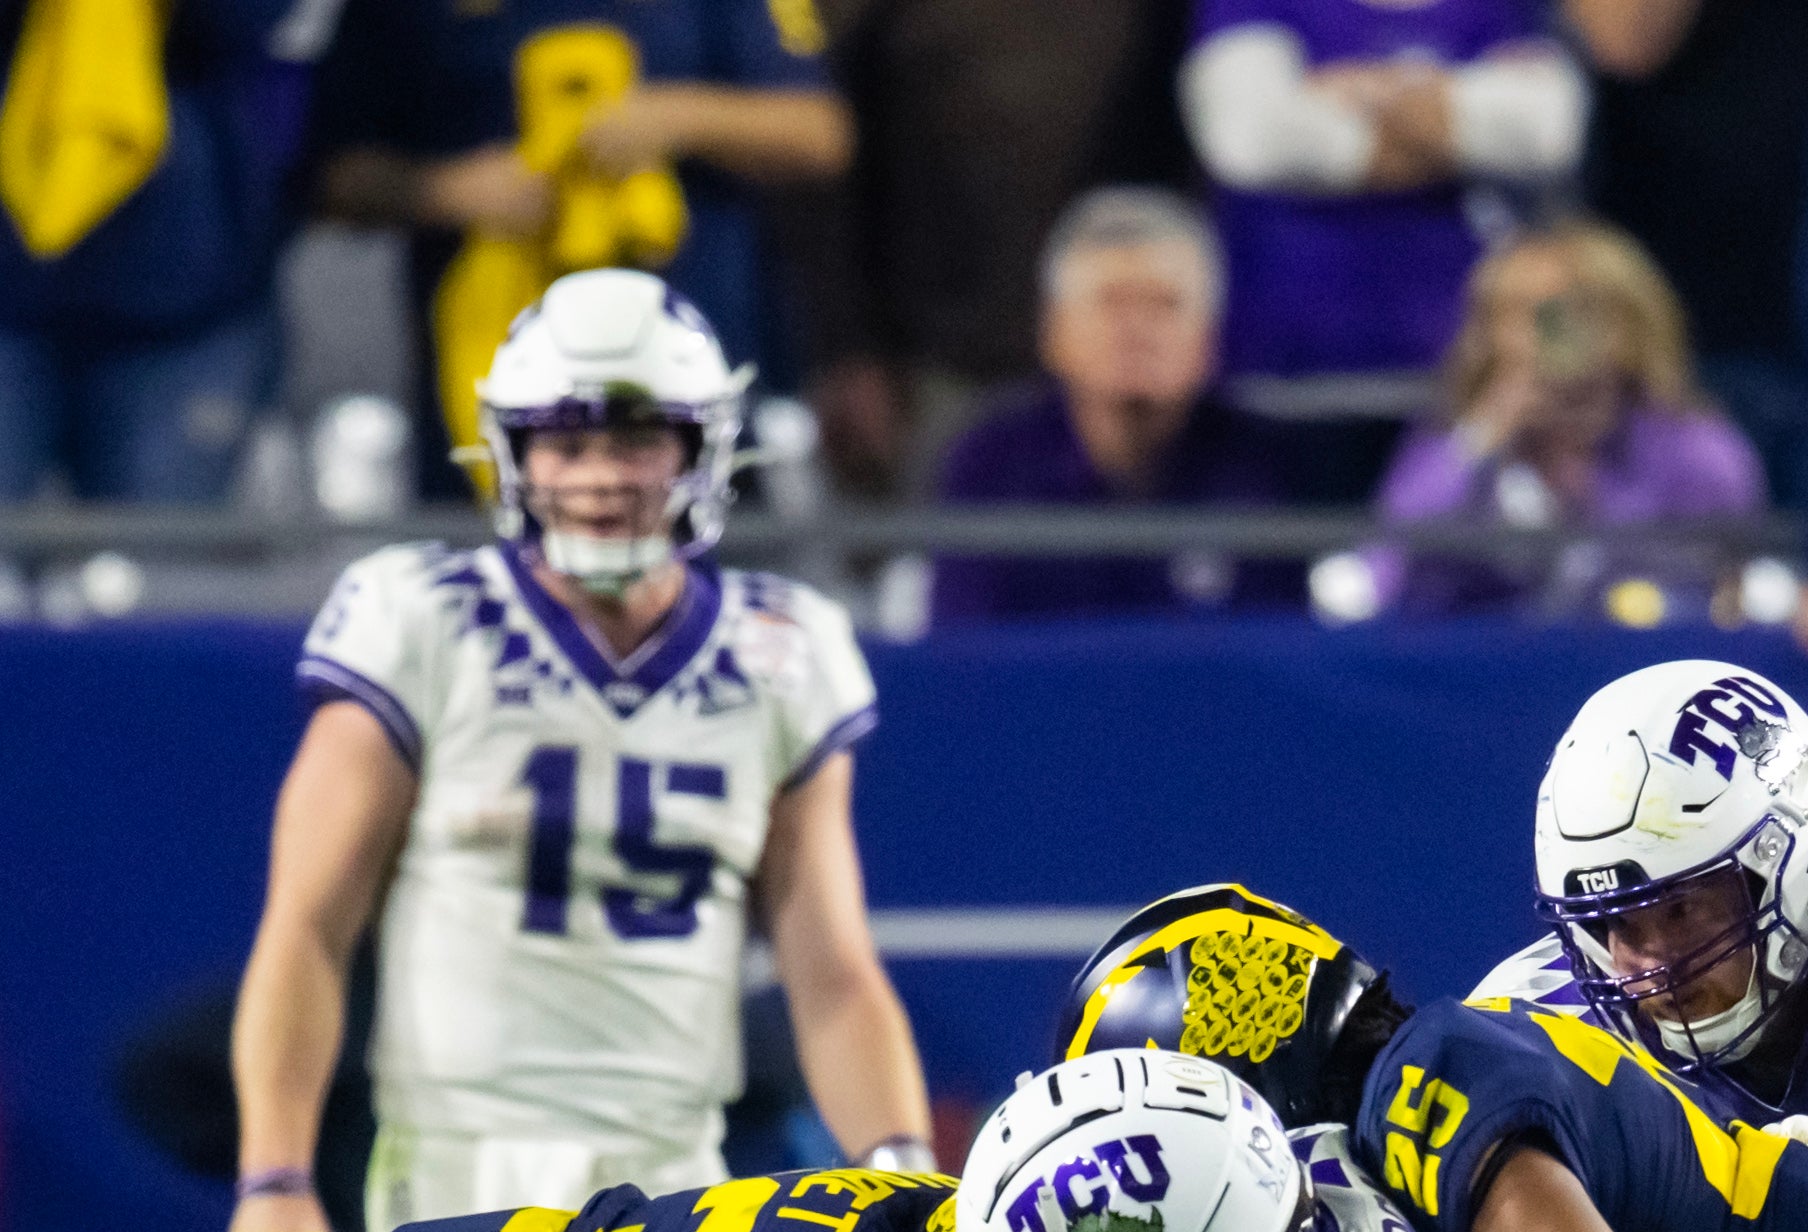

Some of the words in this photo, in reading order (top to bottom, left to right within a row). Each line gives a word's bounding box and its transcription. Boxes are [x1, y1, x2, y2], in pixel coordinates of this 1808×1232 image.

[1669, 676, 1789, 784] TCU
[521, 744, 729, 941] 15
[1576, 868, 1619, 895] TCU
[1384, 1064, 1470, 1217] 25
